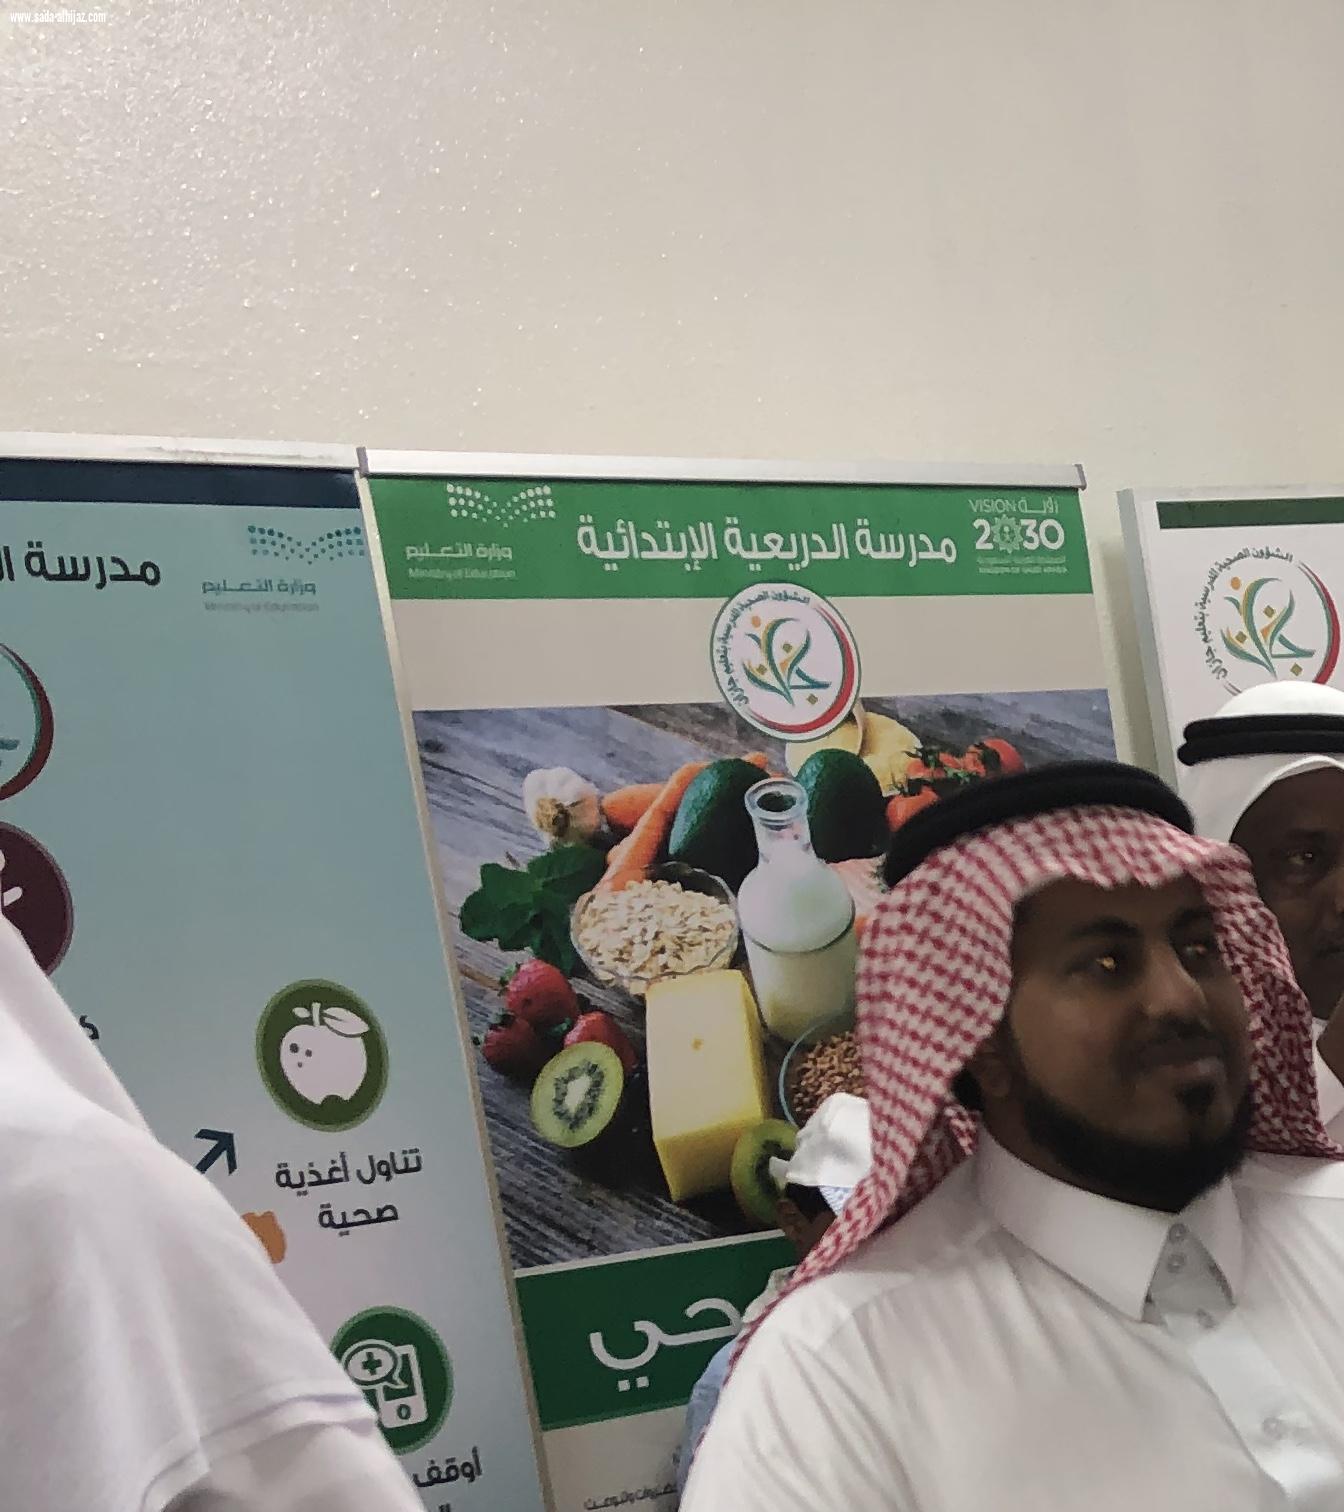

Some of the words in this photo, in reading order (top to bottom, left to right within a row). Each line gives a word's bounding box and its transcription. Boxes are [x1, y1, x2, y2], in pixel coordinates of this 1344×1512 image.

[968, 498, 1017, 514] VISION
[24, 540, 161, 590] مدرسة
[576, 514, 718, 572] الإبتدائية
[723, 516, 849, 572] الدريعية
[855, 517, 957, 568] مدرسة
[274, 1151, 350, 1198] أغذية
[355, 1147, 425, 1186] تناول
[317, 1202, 400, 1237] صحية
[412, 1446, 483, 1488] أوقف
